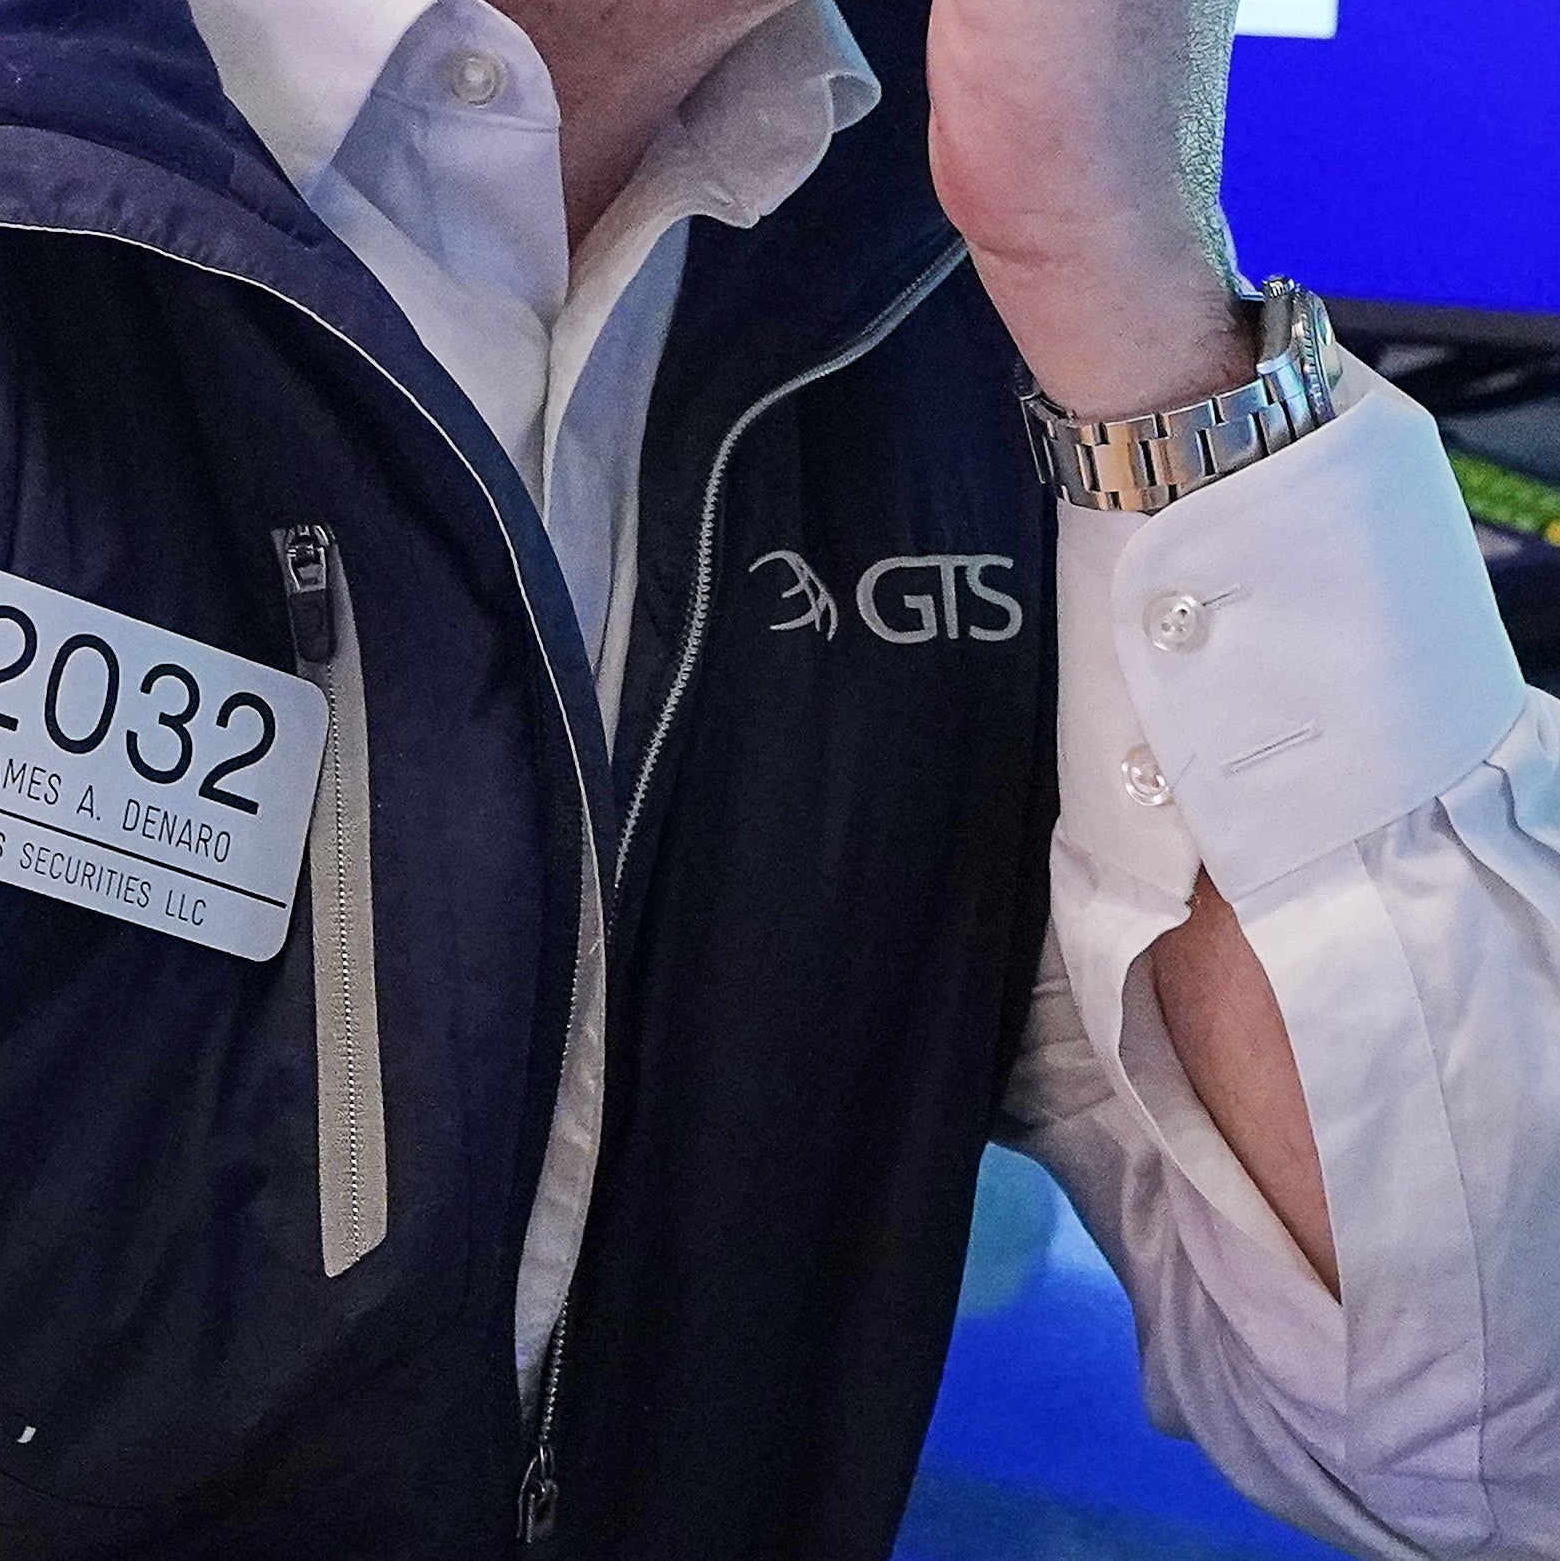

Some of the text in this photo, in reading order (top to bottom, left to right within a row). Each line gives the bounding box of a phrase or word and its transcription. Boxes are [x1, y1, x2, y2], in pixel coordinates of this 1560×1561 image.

[856, 554, 1023, 644] GTS
[75, 785, 101, 821] A.
[122, 799, 231, 863] DENARO
[19, 842, 152, 908] SECURITIES
[165, 890, 207, 927] LLC
